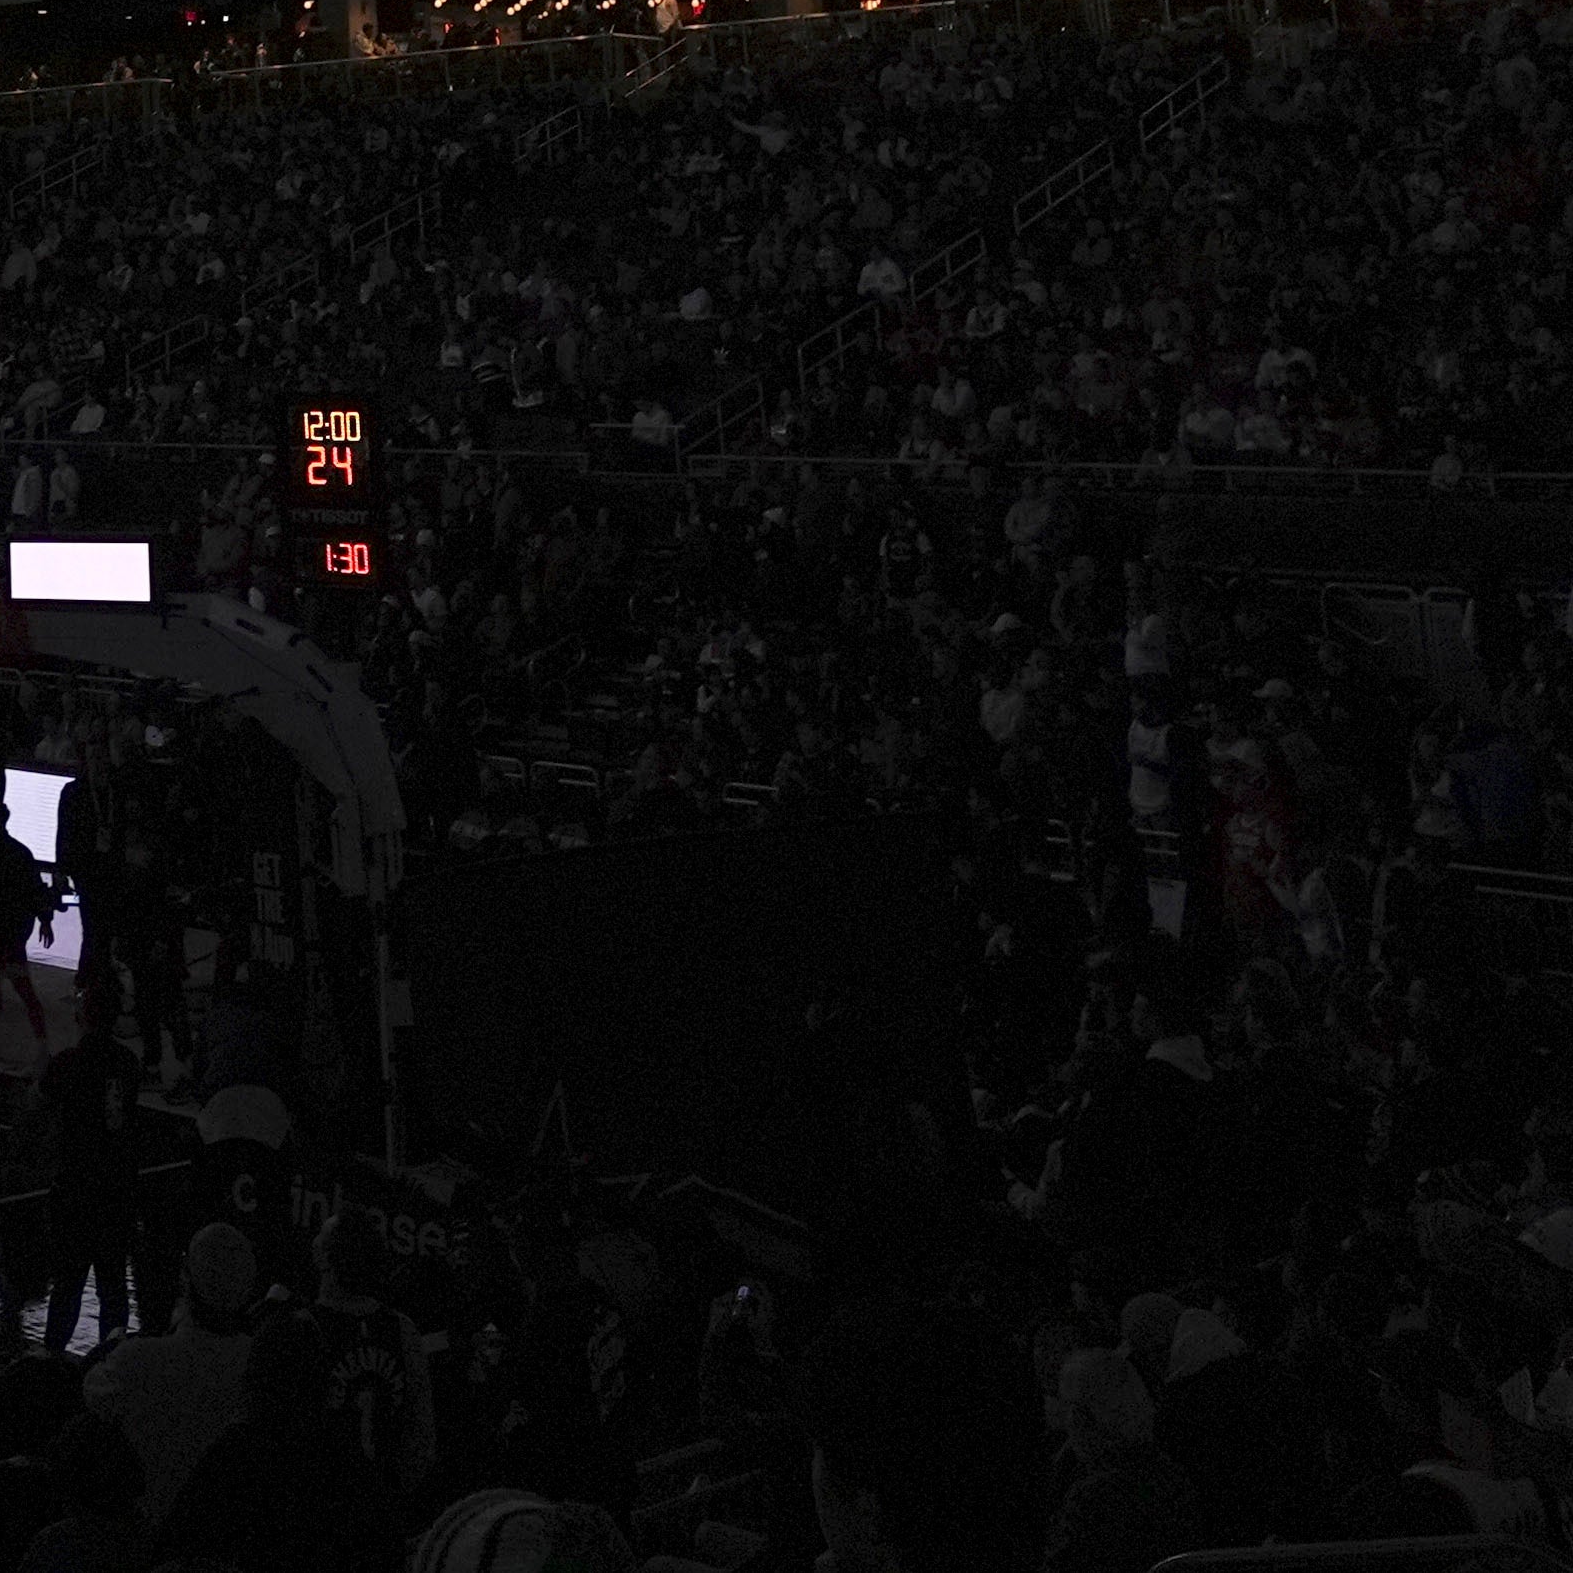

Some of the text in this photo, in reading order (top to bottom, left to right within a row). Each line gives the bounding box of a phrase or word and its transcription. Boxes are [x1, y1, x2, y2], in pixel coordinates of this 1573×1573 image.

[303, 411, 362, 442] 12:00
[306, 445, 354, 486] 24
[325, 542, 370, 575] 1:30
